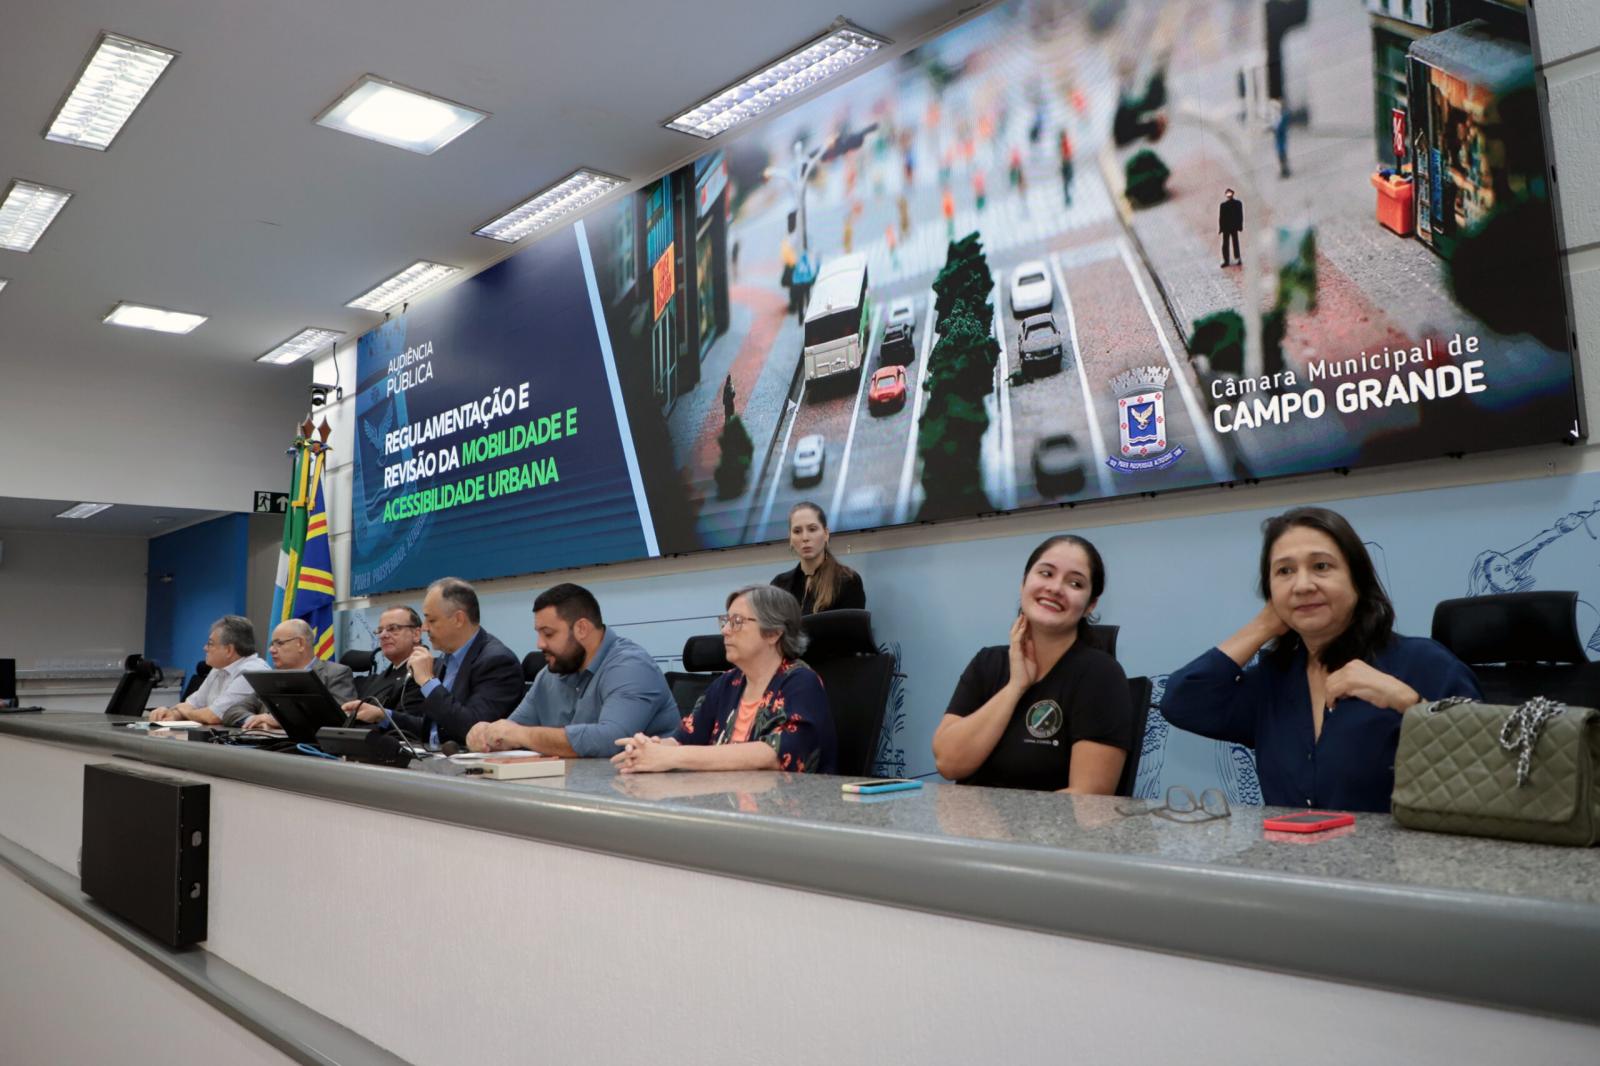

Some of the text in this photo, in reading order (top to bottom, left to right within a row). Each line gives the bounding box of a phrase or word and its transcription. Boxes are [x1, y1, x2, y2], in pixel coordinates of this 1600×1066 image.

[386, 361, 434, 398] PÚBLICA
[387, 340, 434, 374] AUDIÊNCIA
[1211, 334, 1479, 399] Câmara Municipal de
[385, 382, 530, 455] REGULAMENTAÇÃO E
[1213, 360, 1487, 433] CAMPO GRANDE
[384, 407, 578, 489] REVISÃO DA MOBILIDADE E
[383, 456, 560, 523] ACESSIBILIDADE URBANA
